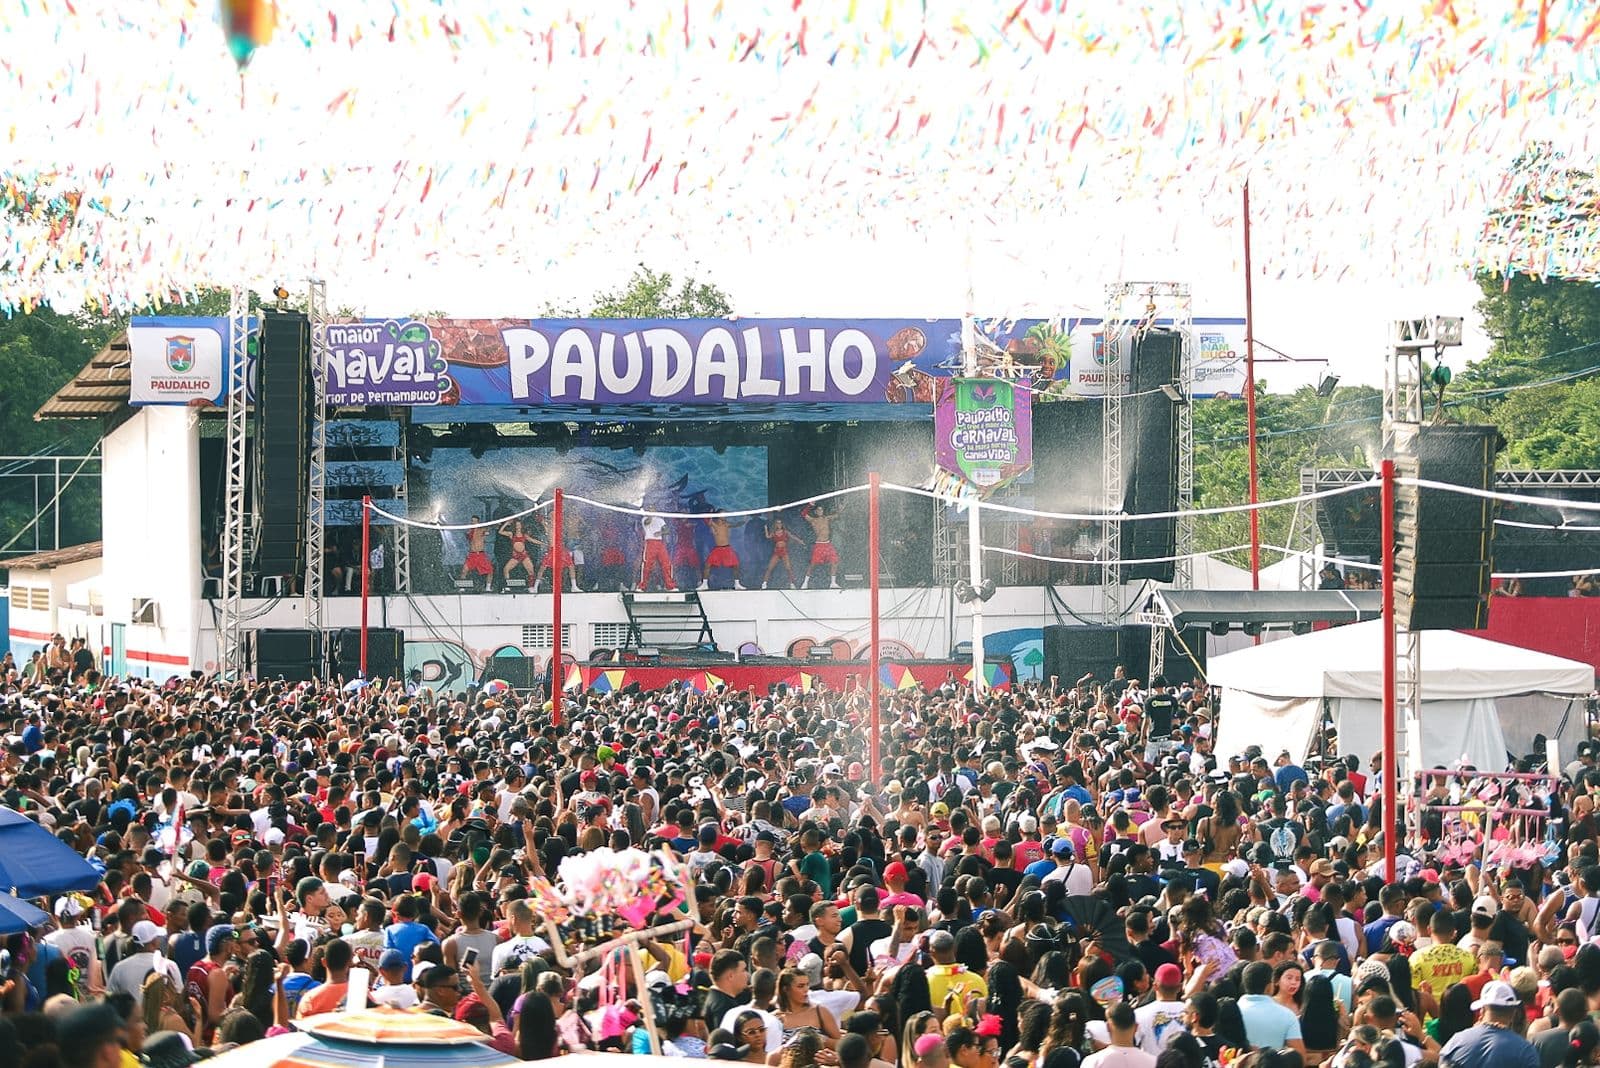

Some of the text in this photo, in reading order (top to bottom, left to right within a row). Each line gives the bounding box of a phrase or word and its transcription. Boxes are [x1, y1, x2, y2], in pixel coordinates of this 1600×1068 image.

[330, 327, 382, 344] maior
[502, 327, 877, 401] PAUDALHO
[151, 380, 210, 390] PAUDALHO
